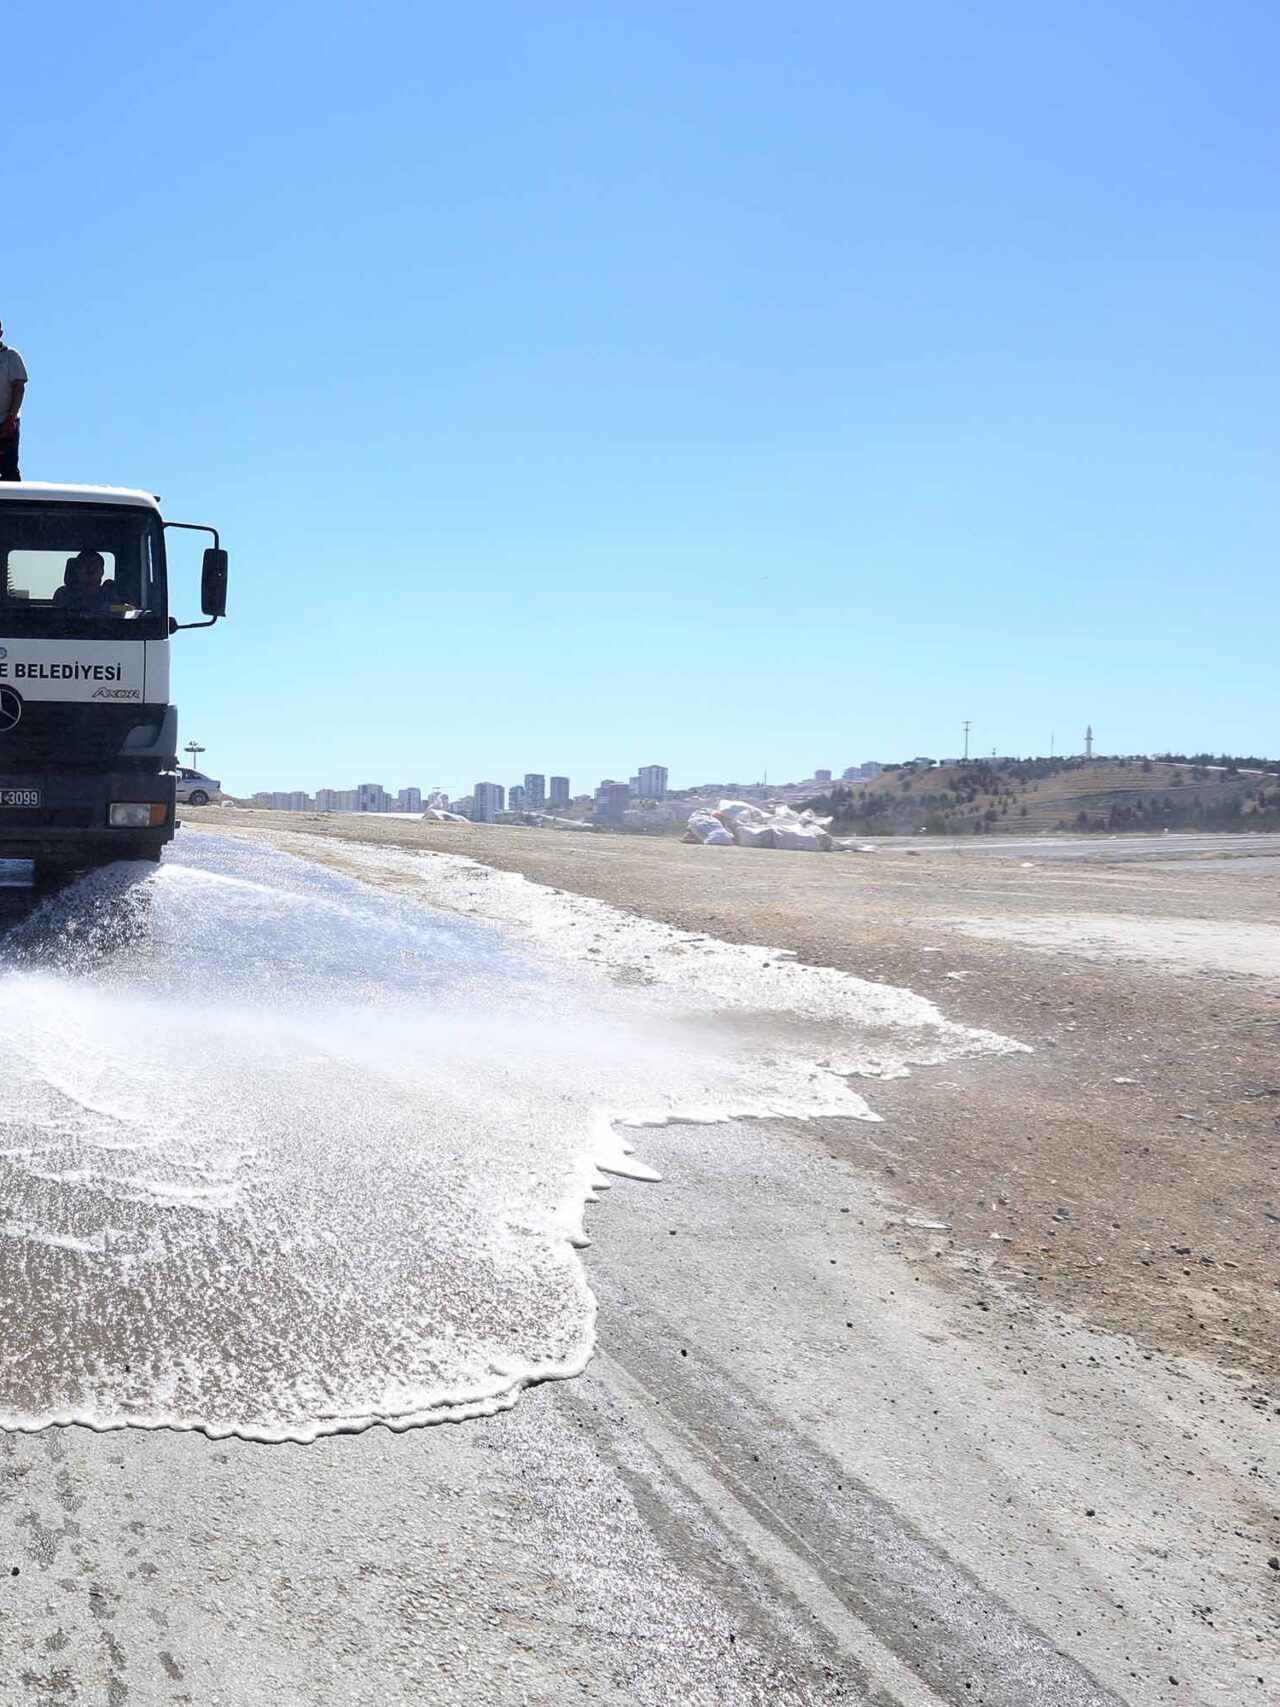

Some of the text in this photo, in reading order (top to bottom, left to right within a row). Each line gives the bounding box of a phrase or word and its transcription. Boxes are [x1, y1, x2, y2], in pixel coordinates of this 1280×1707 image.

[15, 661, 122, 681] BELEDİYESİ
[92, 686, 140, 698] AXOR
[9, 791, 38, 805] 3099
